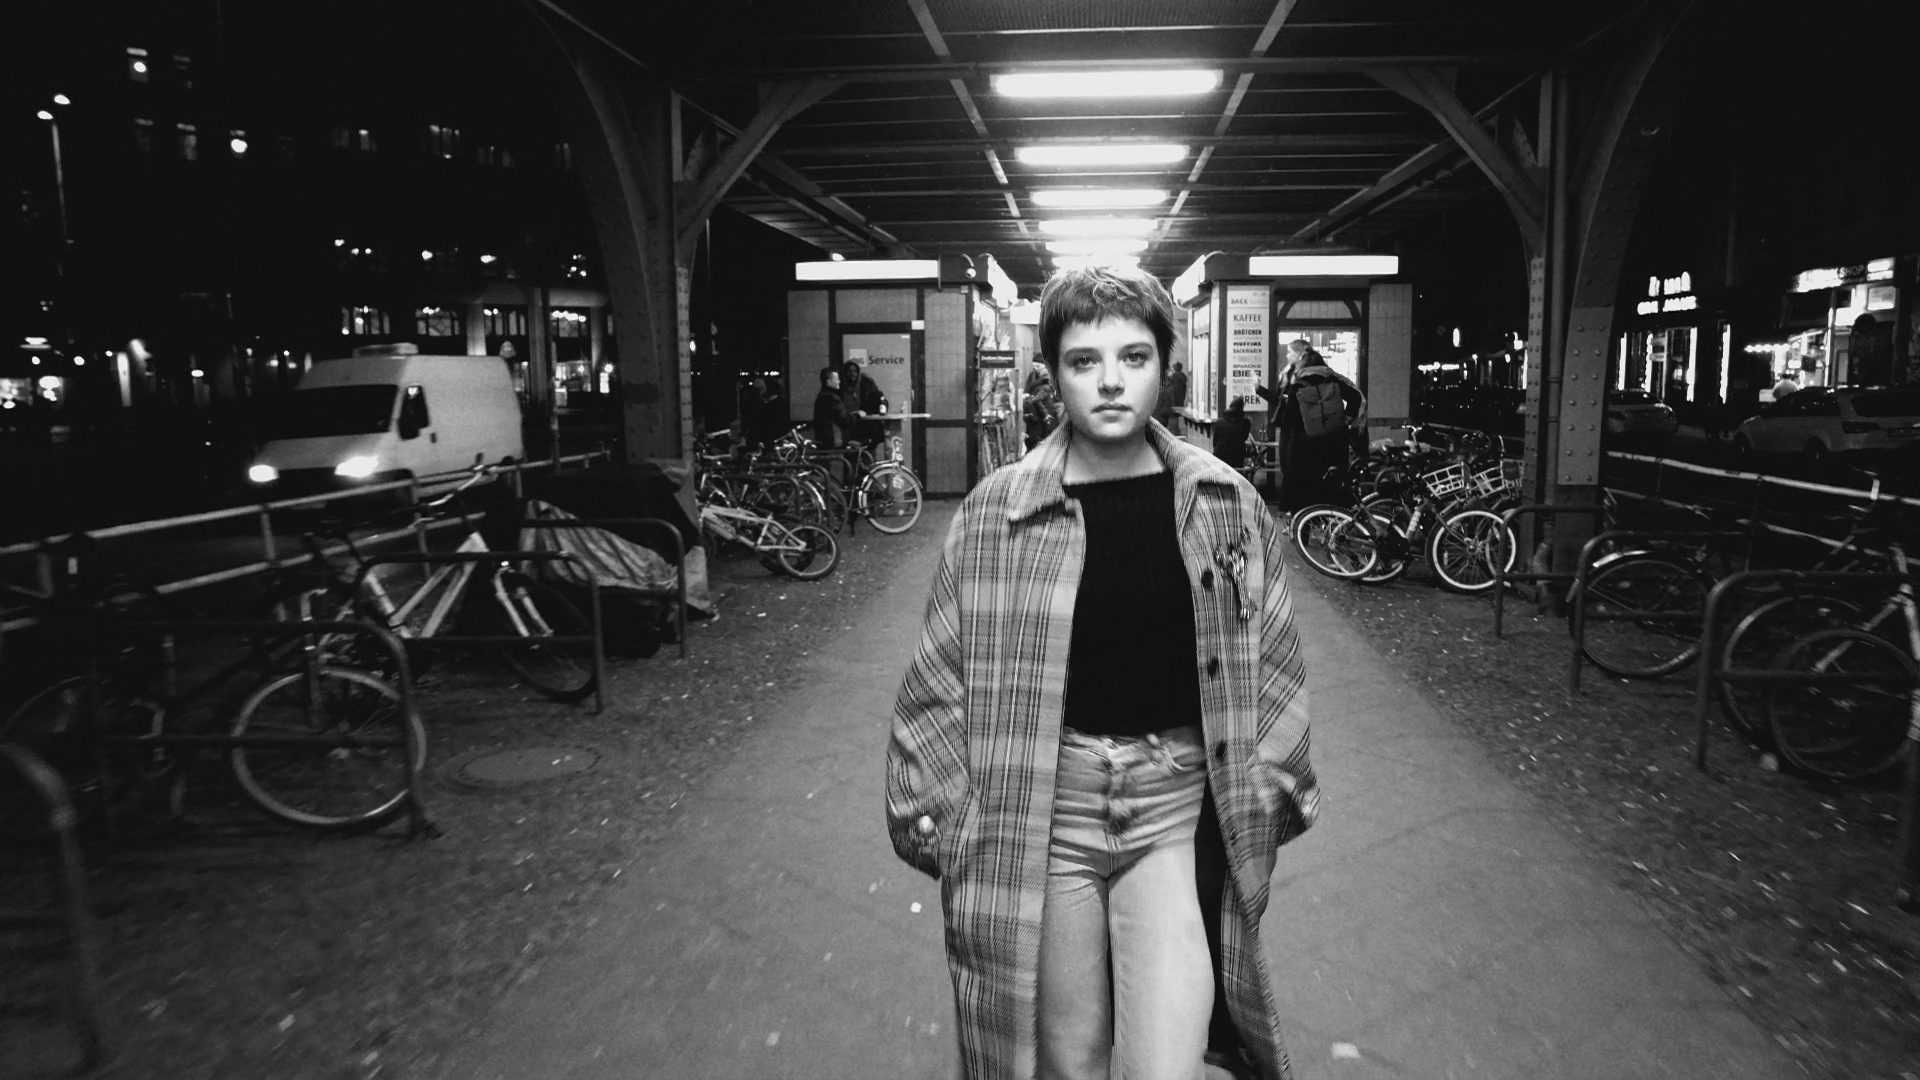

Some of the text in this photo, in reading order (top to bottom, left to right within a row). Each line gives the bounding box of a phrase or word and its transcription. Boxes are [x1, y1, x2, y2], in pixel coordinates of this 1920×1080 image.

[1838, 264, 1864, 279] SHOP
[1233, 313, 1262, 322] KAFFEE
[868, 355, 905, 365] Service
